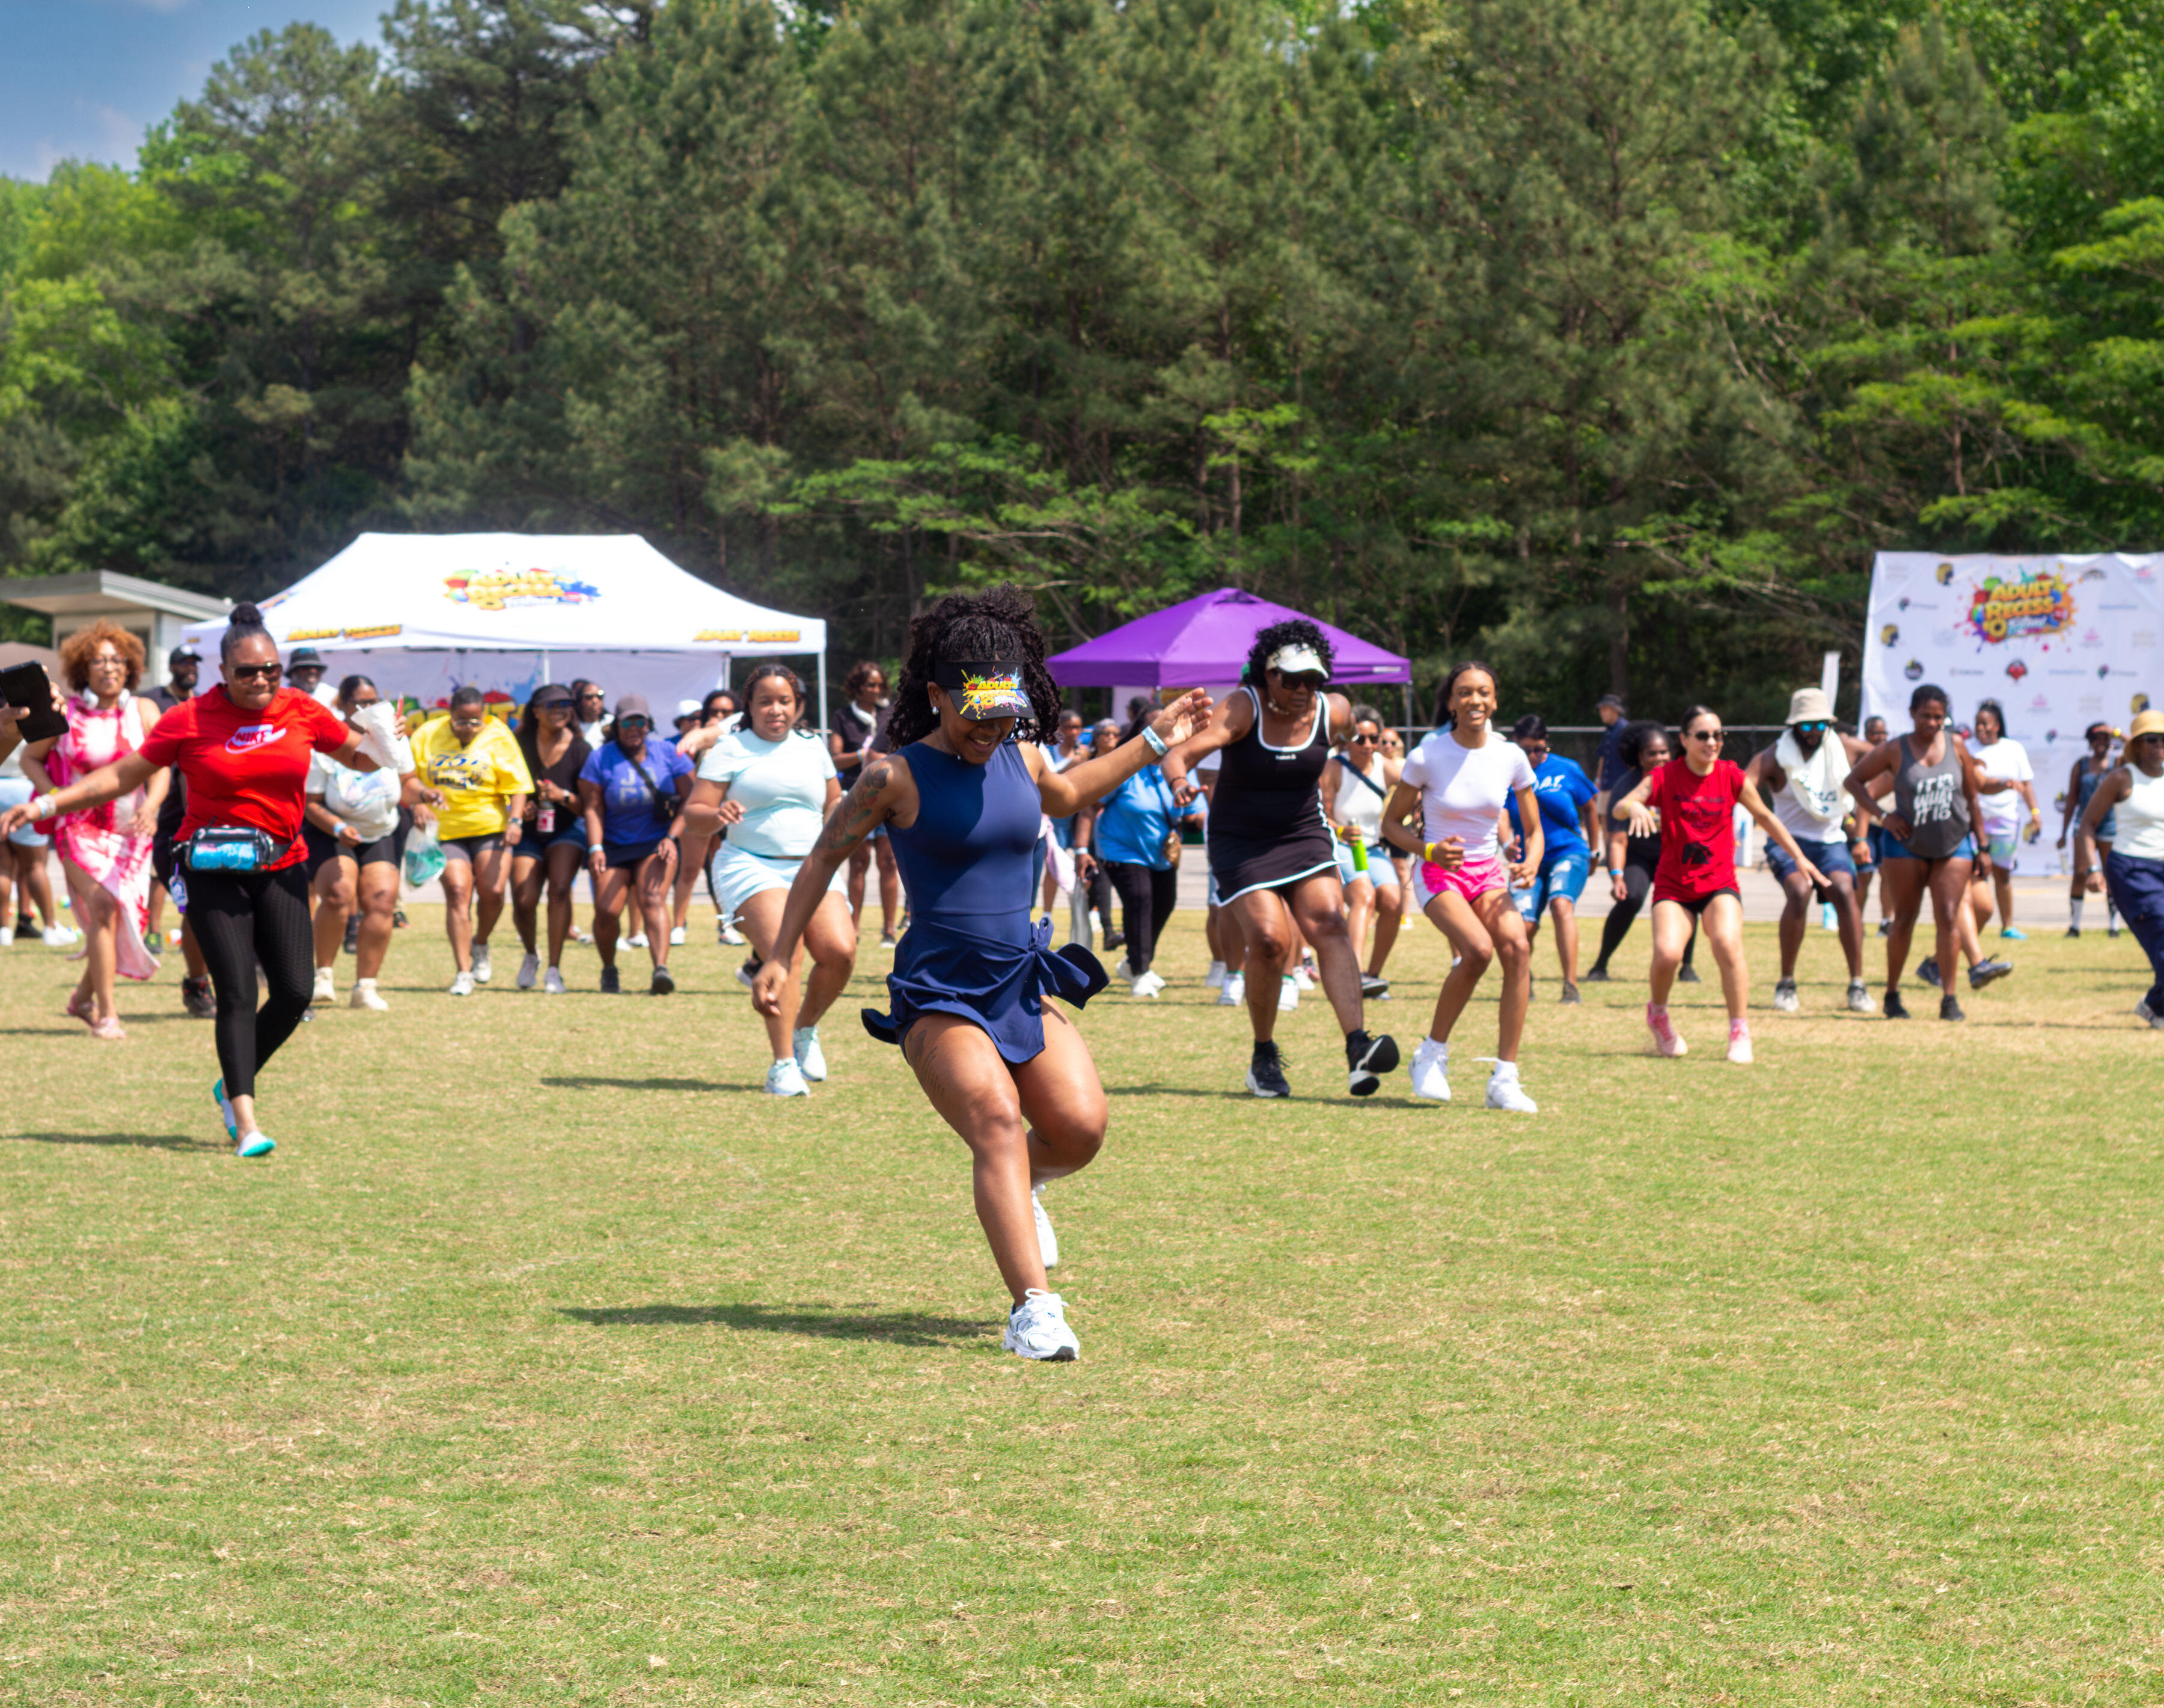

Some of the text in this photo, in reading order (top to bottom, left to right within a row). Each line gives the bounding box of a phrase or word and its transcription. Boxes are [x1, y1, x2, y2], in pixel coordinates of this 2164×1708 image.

[1990, 580, 2054, 601] ADULT
[1985, 596, 2055, 620] RECESS
[235, 730, 268, 744] NIKE
[1916, 777, 1936, 794] IT
[1913, 789, 1953, 812] WHAT
